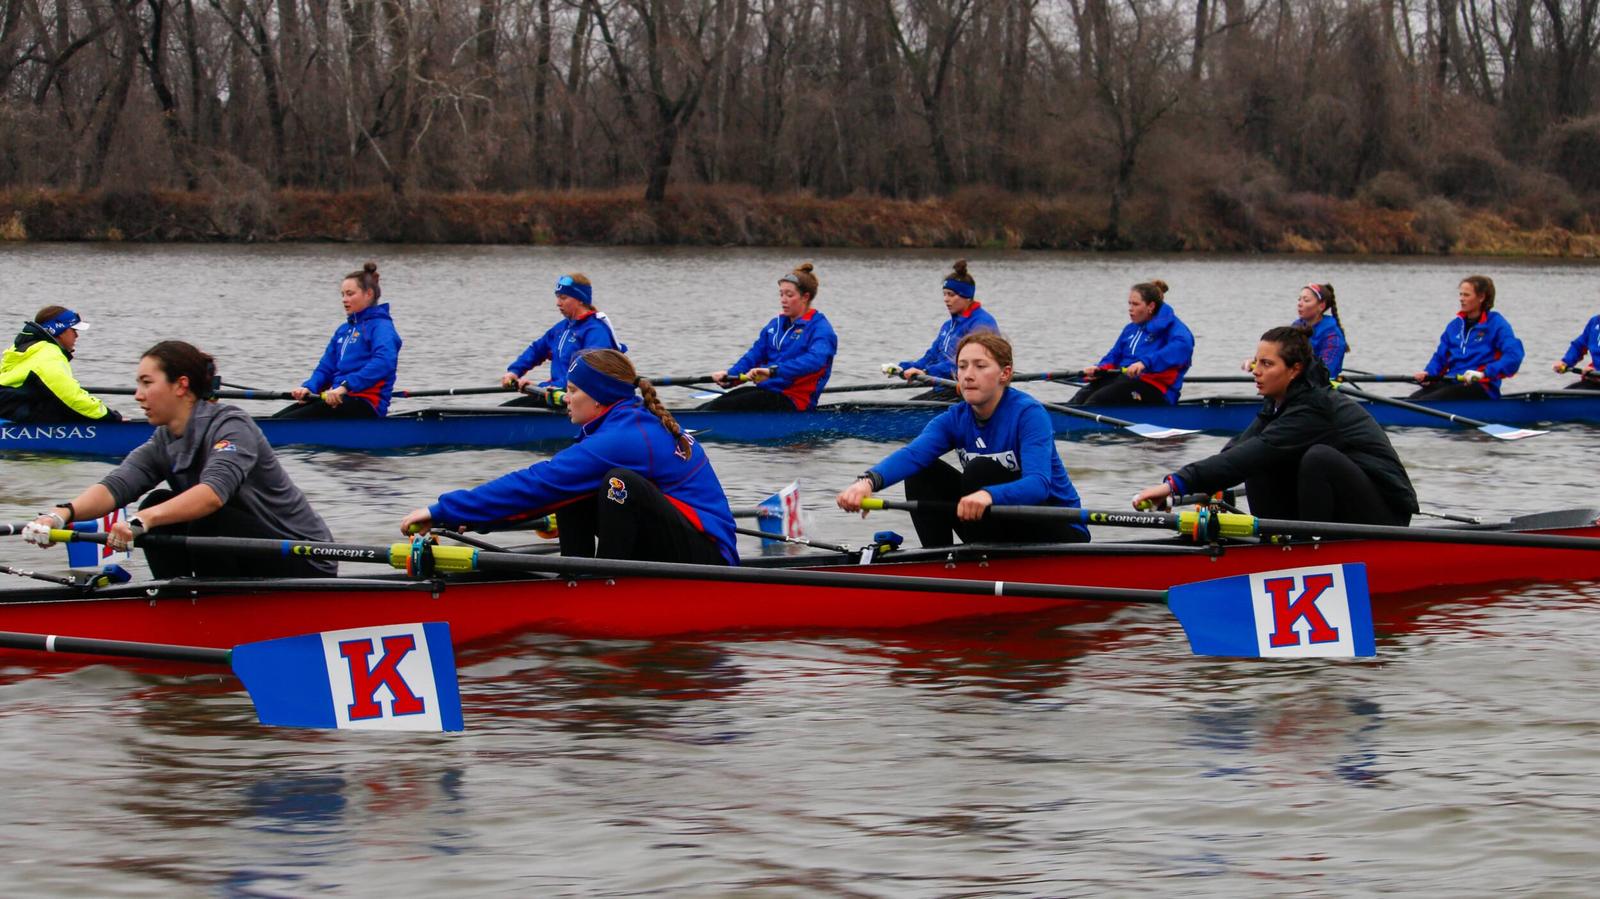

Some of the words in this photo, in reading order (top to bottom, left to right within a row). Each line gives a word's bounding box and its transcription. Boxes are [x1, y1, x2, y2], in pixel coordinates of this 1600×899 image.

[0, 426, 97, 440] KANSAS
[1108, 514, 1155, 524] concept
[1158, 516, 1166, 525] 2
[312, 547, 365, 558] concept
[367, 549, 376, 559] 2
[1263, 572, 1340, 649] K
[338, 633, 426, 722] K
